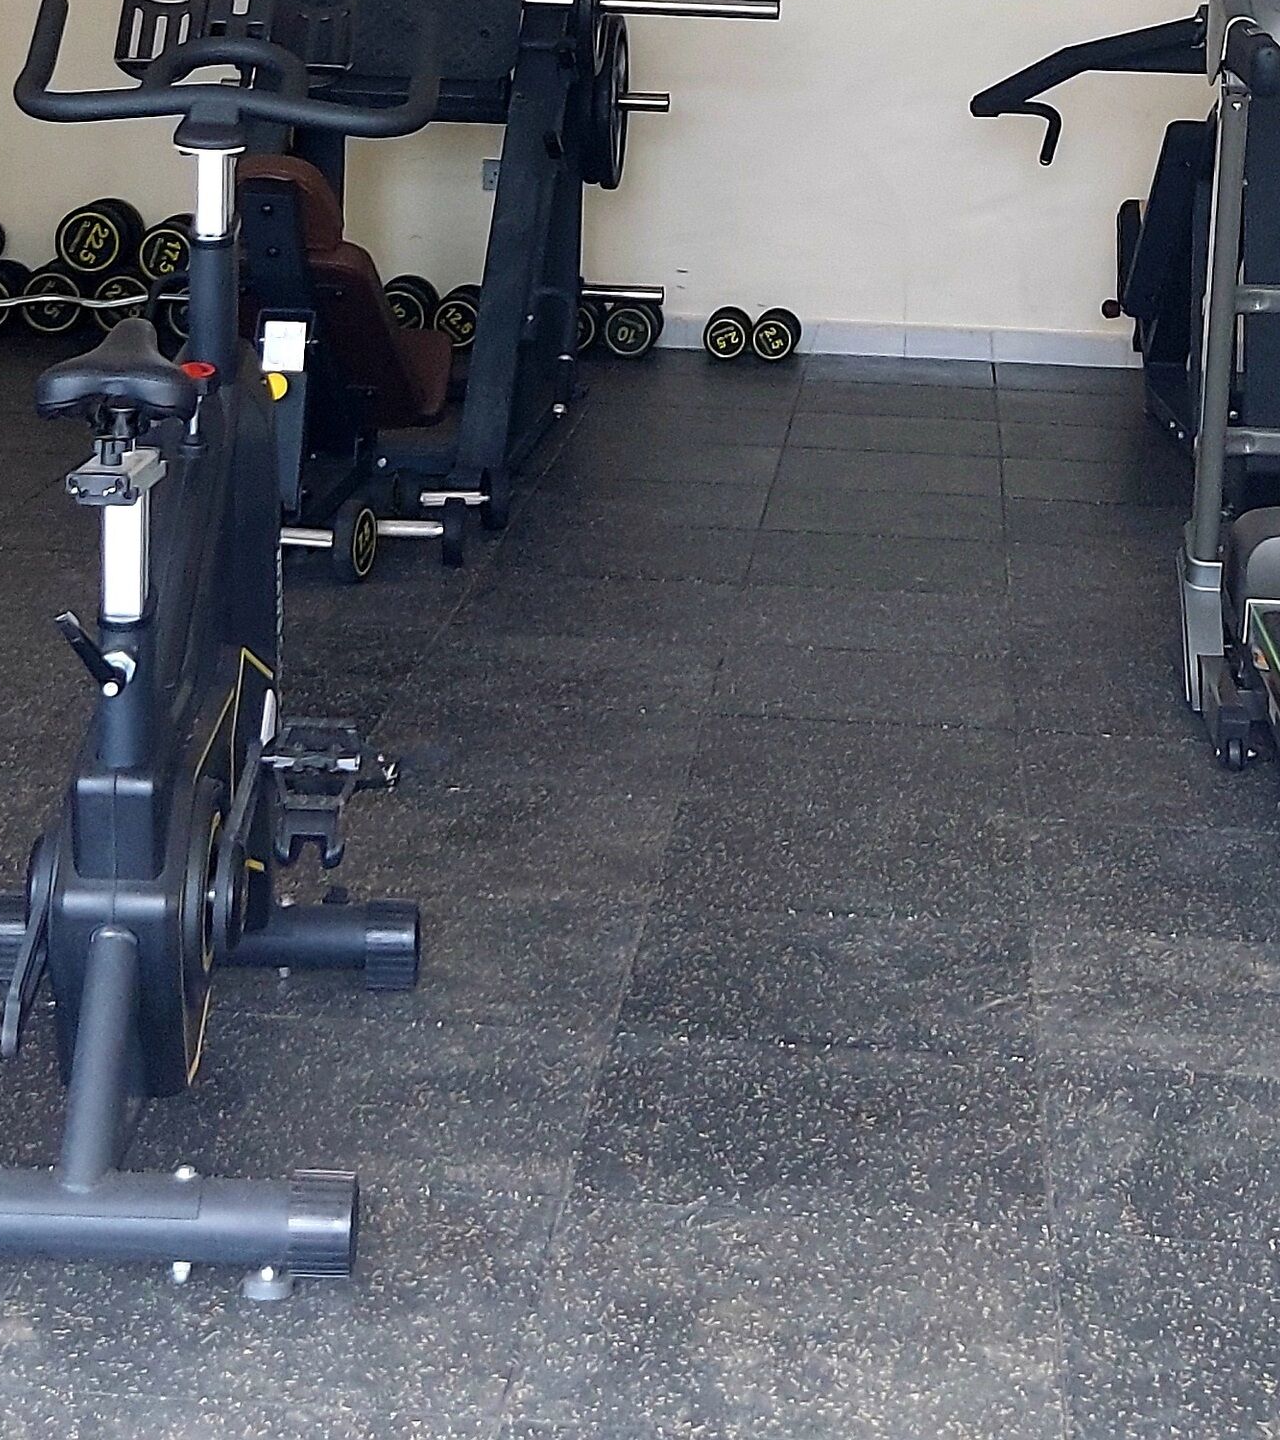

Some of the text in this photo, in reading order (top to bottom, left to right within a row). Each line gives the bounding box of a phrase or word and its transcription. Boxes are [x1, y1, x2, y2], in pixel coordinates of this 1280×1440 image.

[81, 223, 109, 264] 22.5
[160, 242, 181, 273] 17.5
[446, 308, 473, 334] 12.5
[618, 326, 635, 344] 10
[716, 331, 739, 349] 2.5
[764, 327, 784, 350] 2.5
